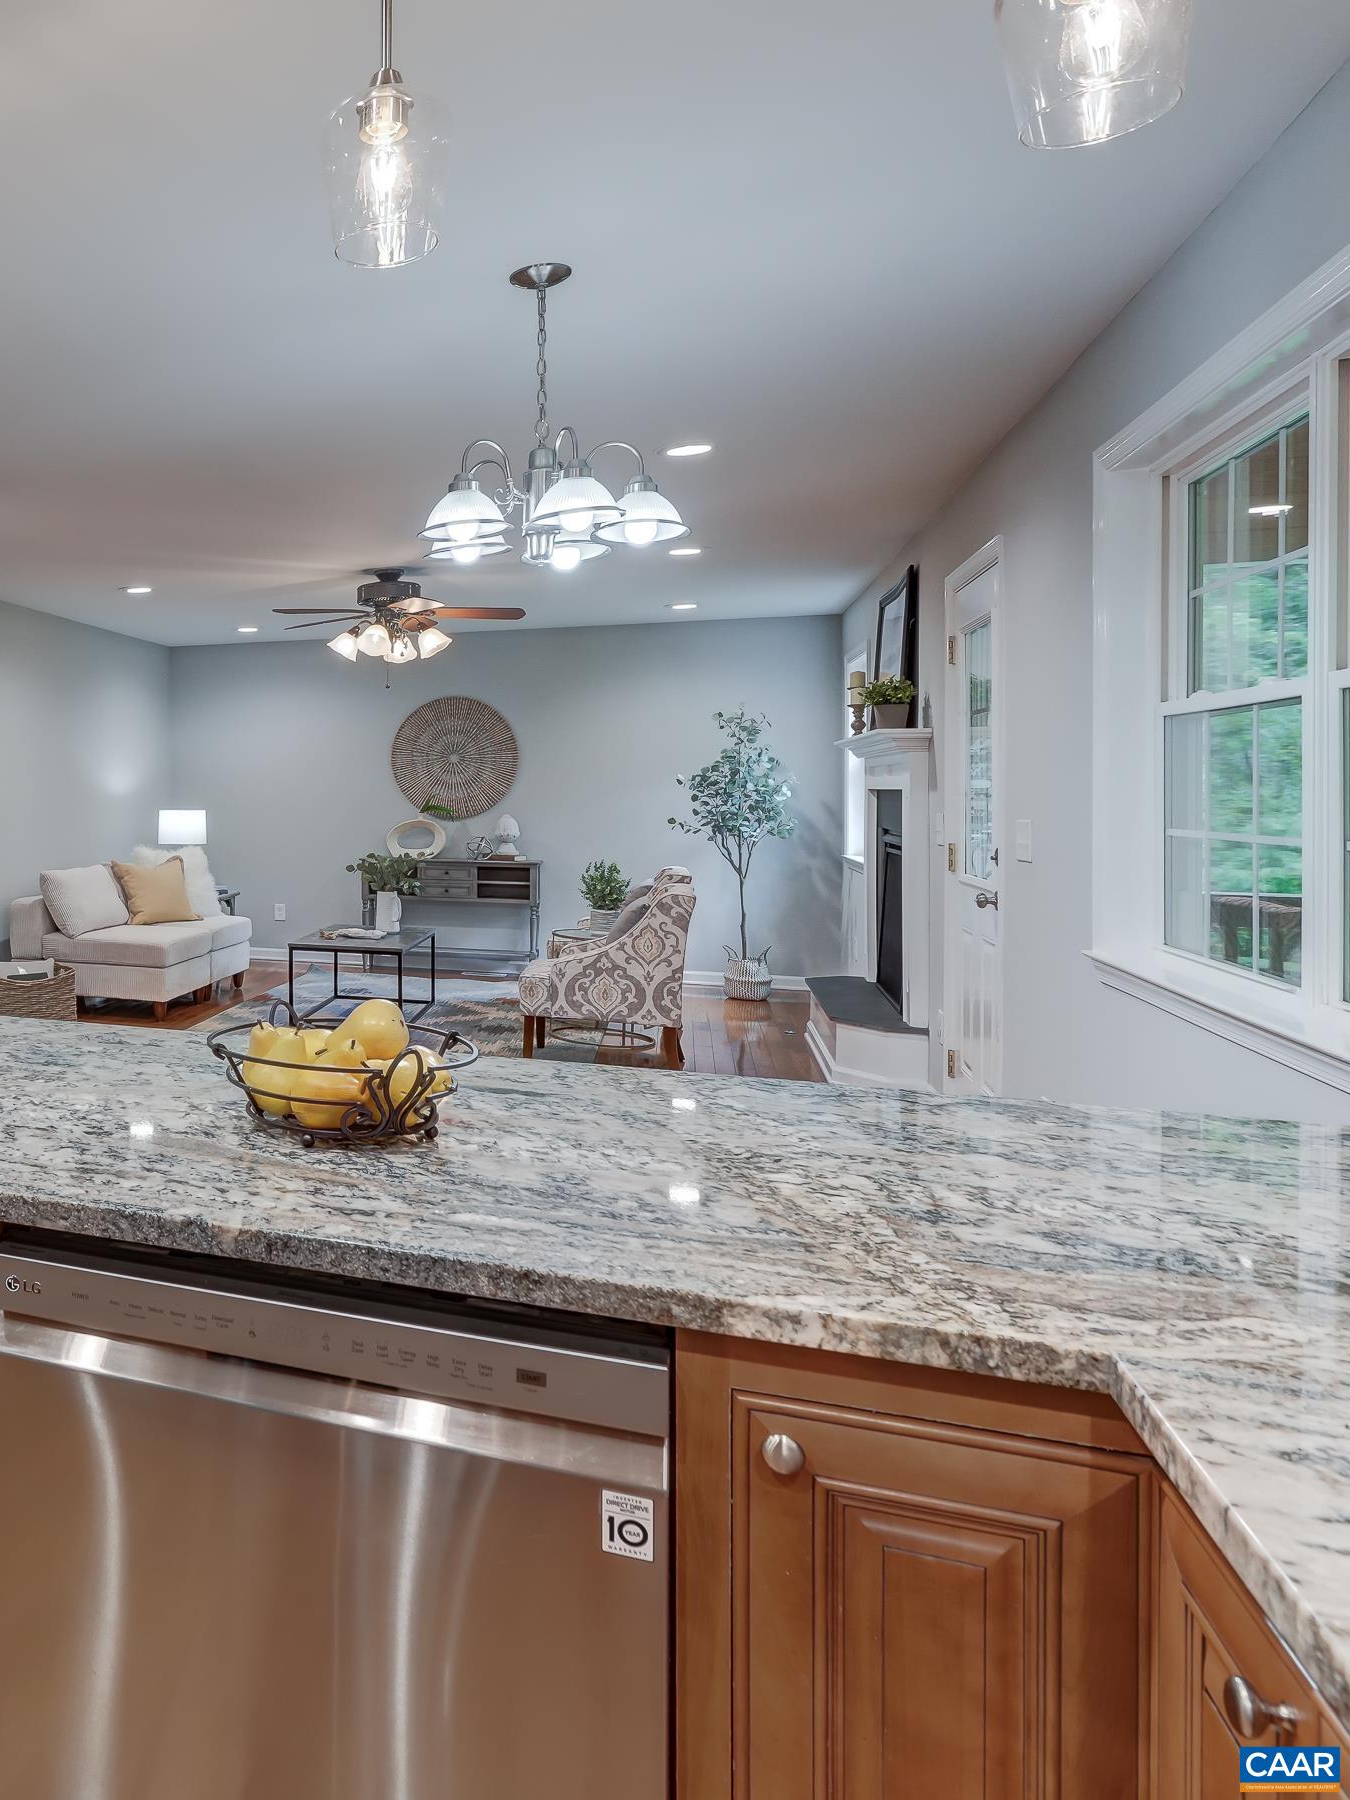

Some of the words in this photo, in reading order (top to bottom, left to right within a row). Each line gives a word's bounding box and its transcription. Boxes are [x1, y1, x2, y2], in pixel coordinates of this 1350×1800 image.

[23, 1280, 41, 1294] LG
[71, 1291, 89, 1300] POWER
[606, 1498, 628, 1508] DIRECT
[630, 1503, 649, 1513] DRIVE
[607, 1516, 648, 1547] 10
[625, 1529, 640, 1538] YEAR
[608, 1544, 647, 1557] WARRANTY
